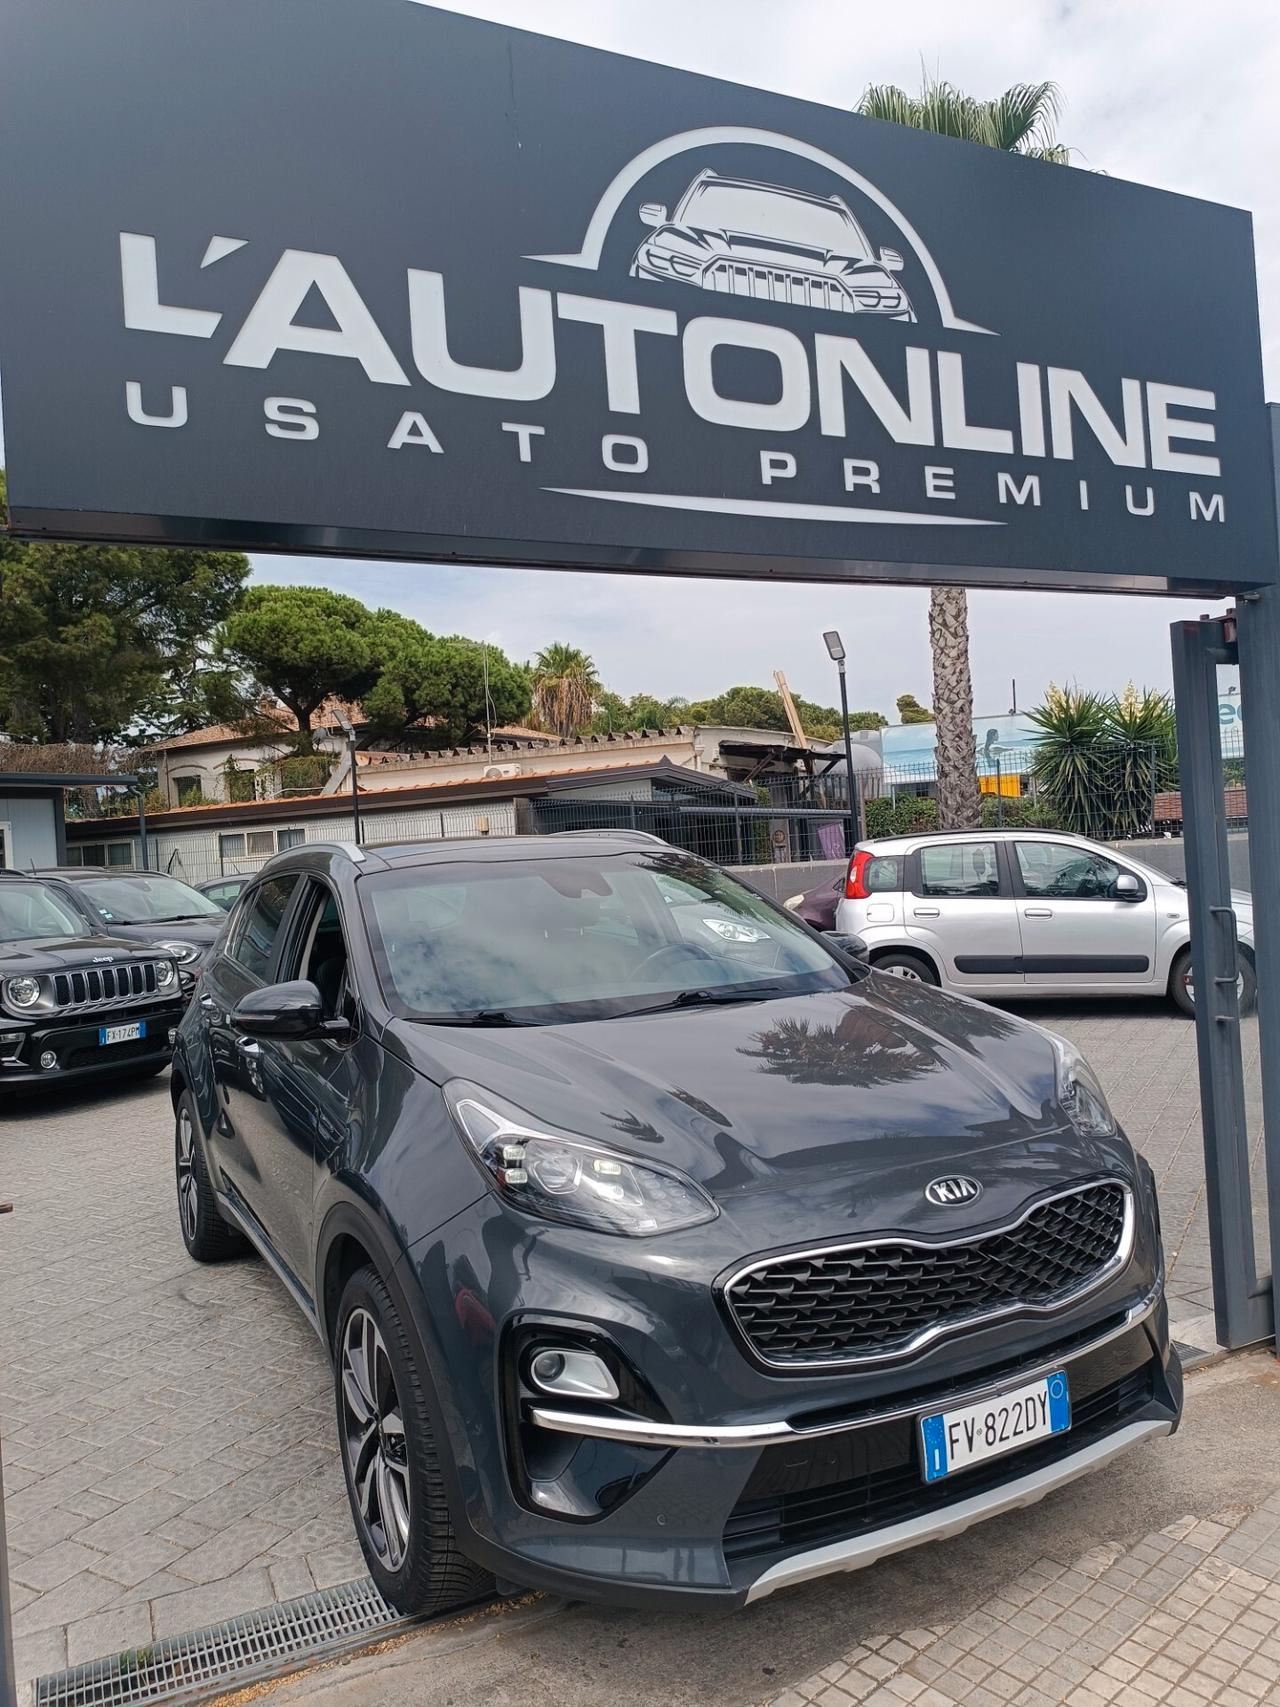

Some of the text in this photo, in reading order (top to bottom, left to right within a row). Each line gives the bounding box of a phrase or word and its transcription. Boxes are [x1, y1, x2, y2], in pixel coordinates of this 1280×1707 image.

[125, 380, 1226, 523] USATO PREMIUM
[932, 1178, 976, 1202] KIA
